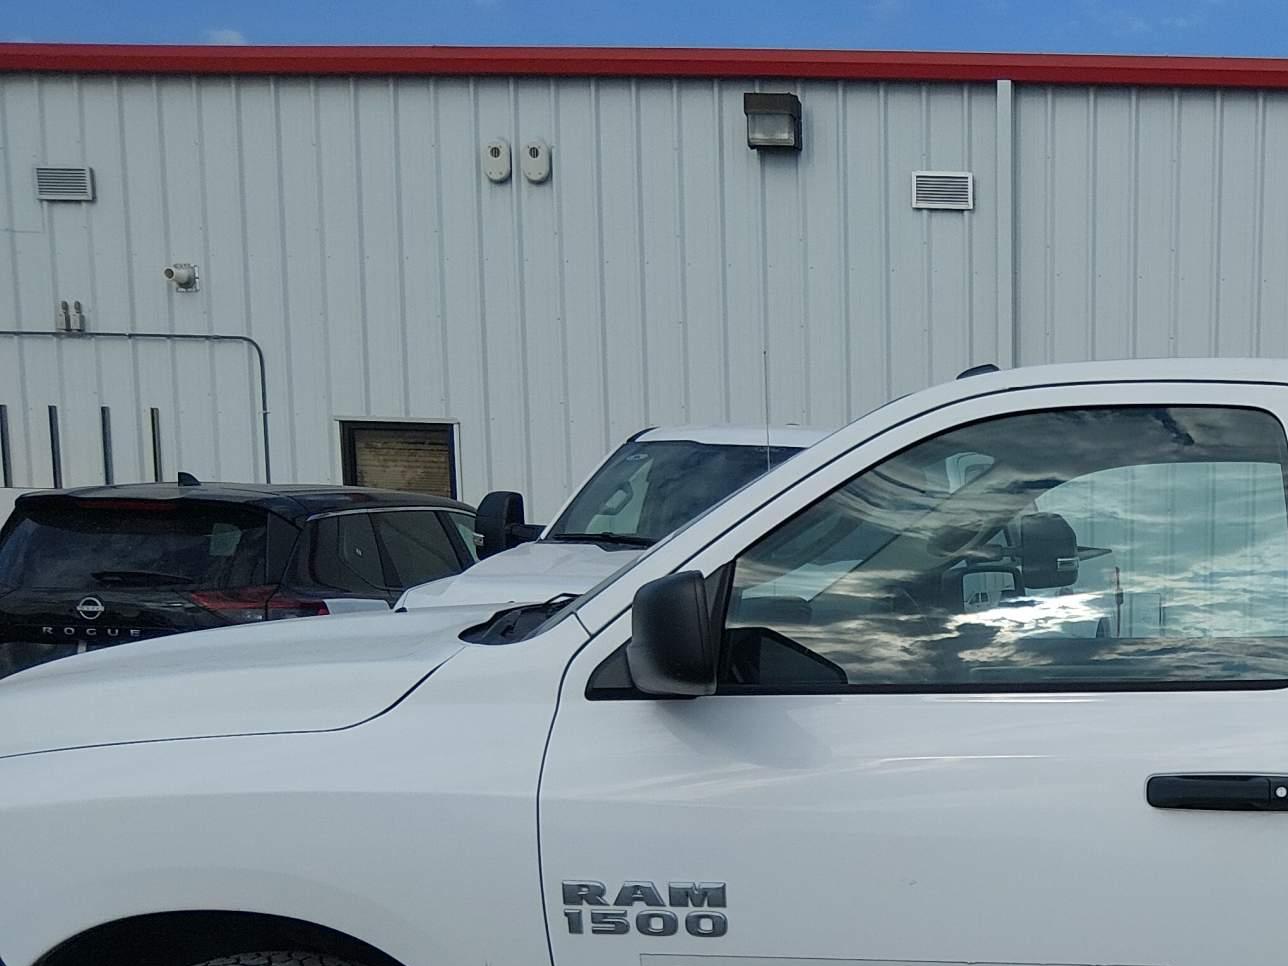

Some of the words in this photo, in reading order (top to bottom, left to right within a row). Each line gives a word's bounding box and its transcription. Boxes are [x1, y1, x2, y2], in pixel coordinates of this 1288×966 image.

[42, 626, 142, 637] ROGUE
[562, 880, 727, 907] RAM
[563, 909, 729, 937] 1500
